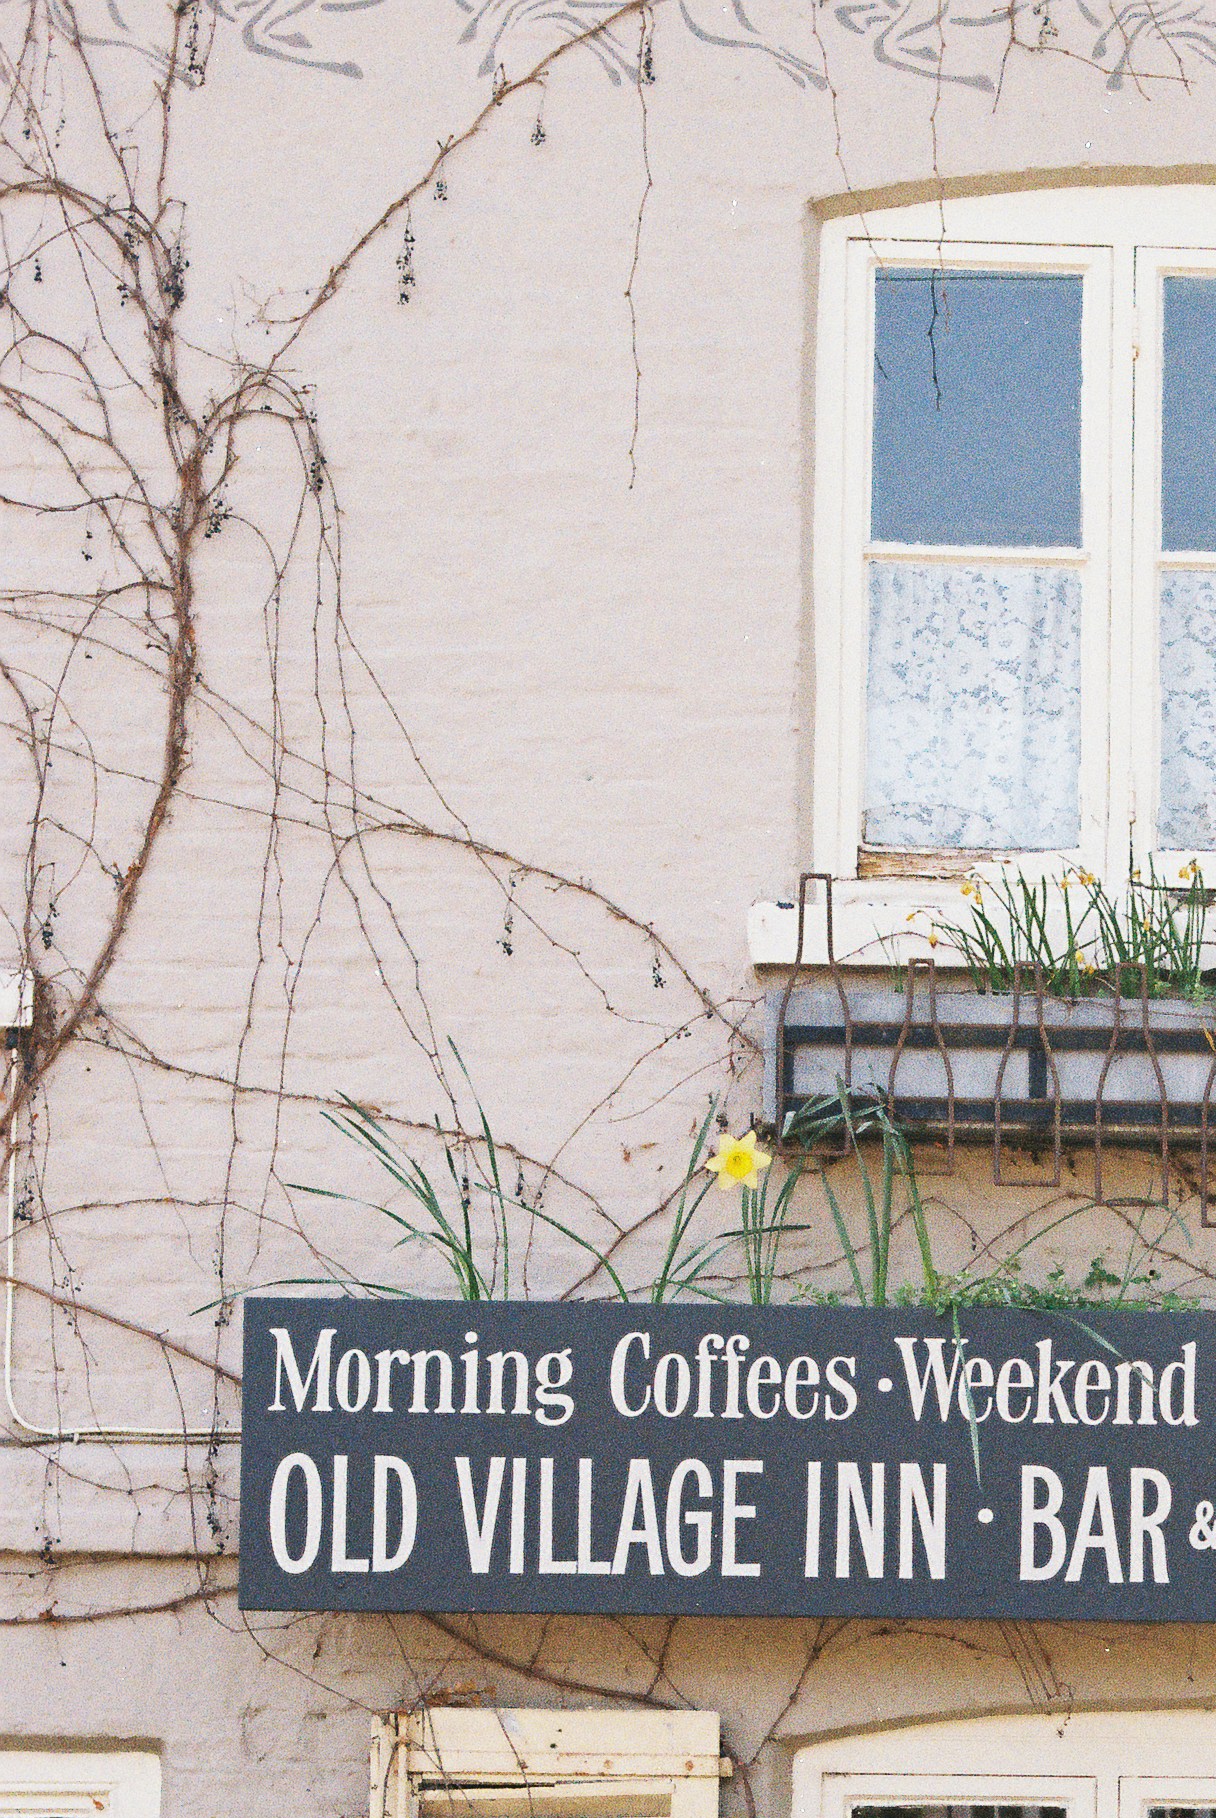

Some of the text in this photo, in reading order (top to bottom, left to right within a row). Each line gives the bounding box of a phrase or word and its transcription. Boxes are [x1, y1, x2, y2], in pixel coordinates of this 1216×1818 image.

[268, 1328, 575, 1426] Morning
[611, 1331, 861, 1420] Coffees
[894, 1338, 1199, 1426] Weekend
[270, 1452, 418, 1574] OLD
[455, 1456, 764, 1577] VILLAGE
[804, 1461, 947, 1580] INN
[1020, 1465, 1171, 1584] BAR
